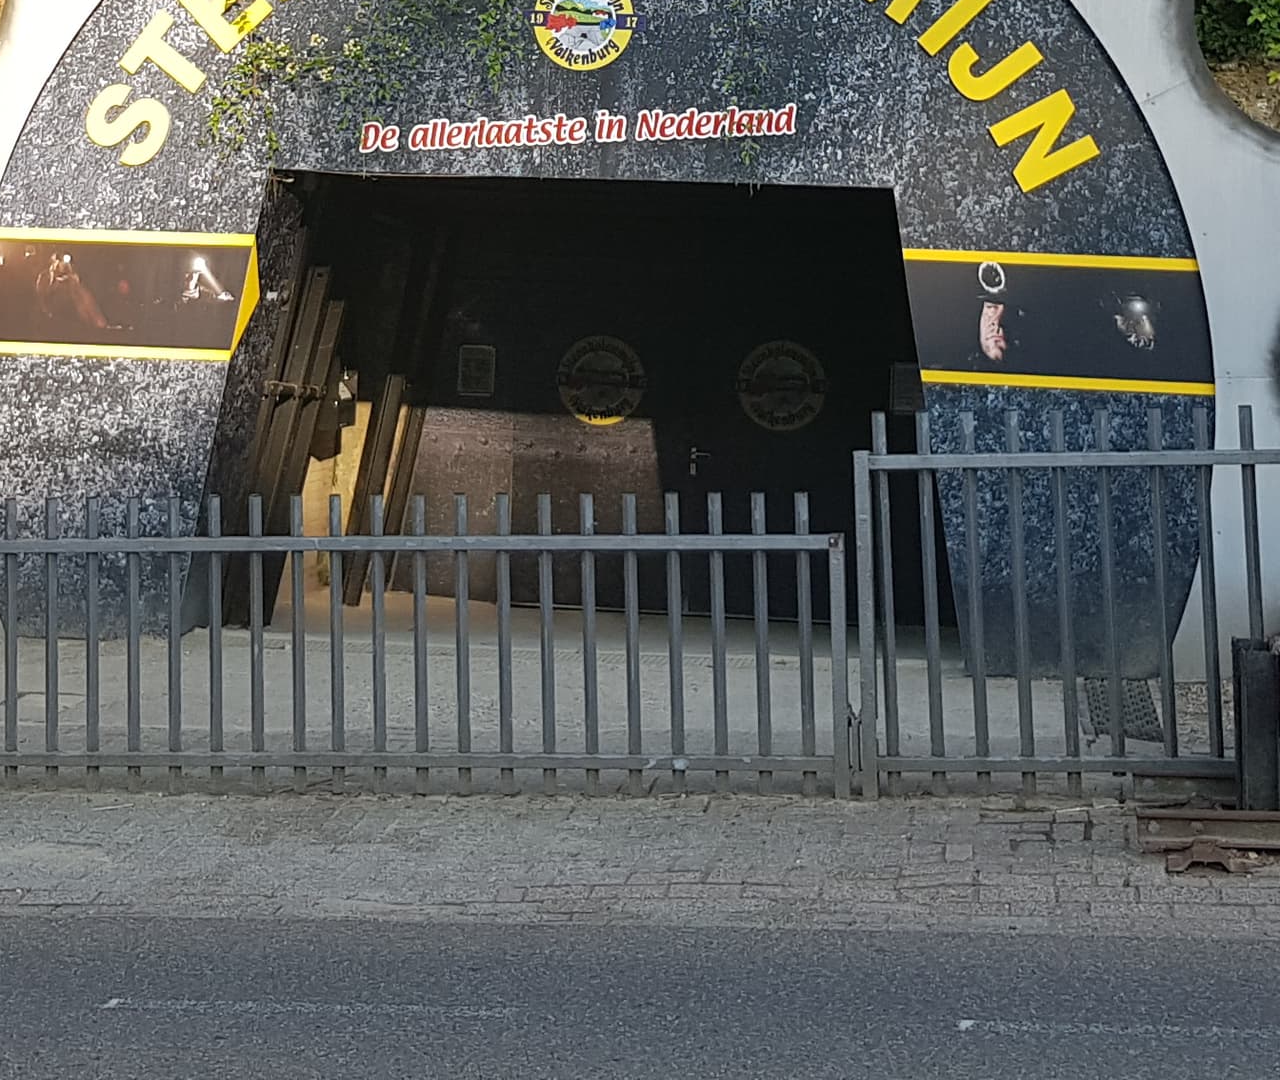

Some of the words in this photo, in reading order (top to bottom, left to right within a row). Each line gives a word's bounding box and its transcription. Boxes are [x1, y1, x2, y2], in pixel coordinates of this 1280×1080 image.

[530, 13, 544, 24] 19
[625, 16, 639, 28] 17
[545, 37, 620, 67] Valkenburg
[360, 122, 399, 152] De
[409, 113, 586, 150] allerlaatste
[596, 109, 626, 142] in
[636, 104, 797, 141] Nederland
